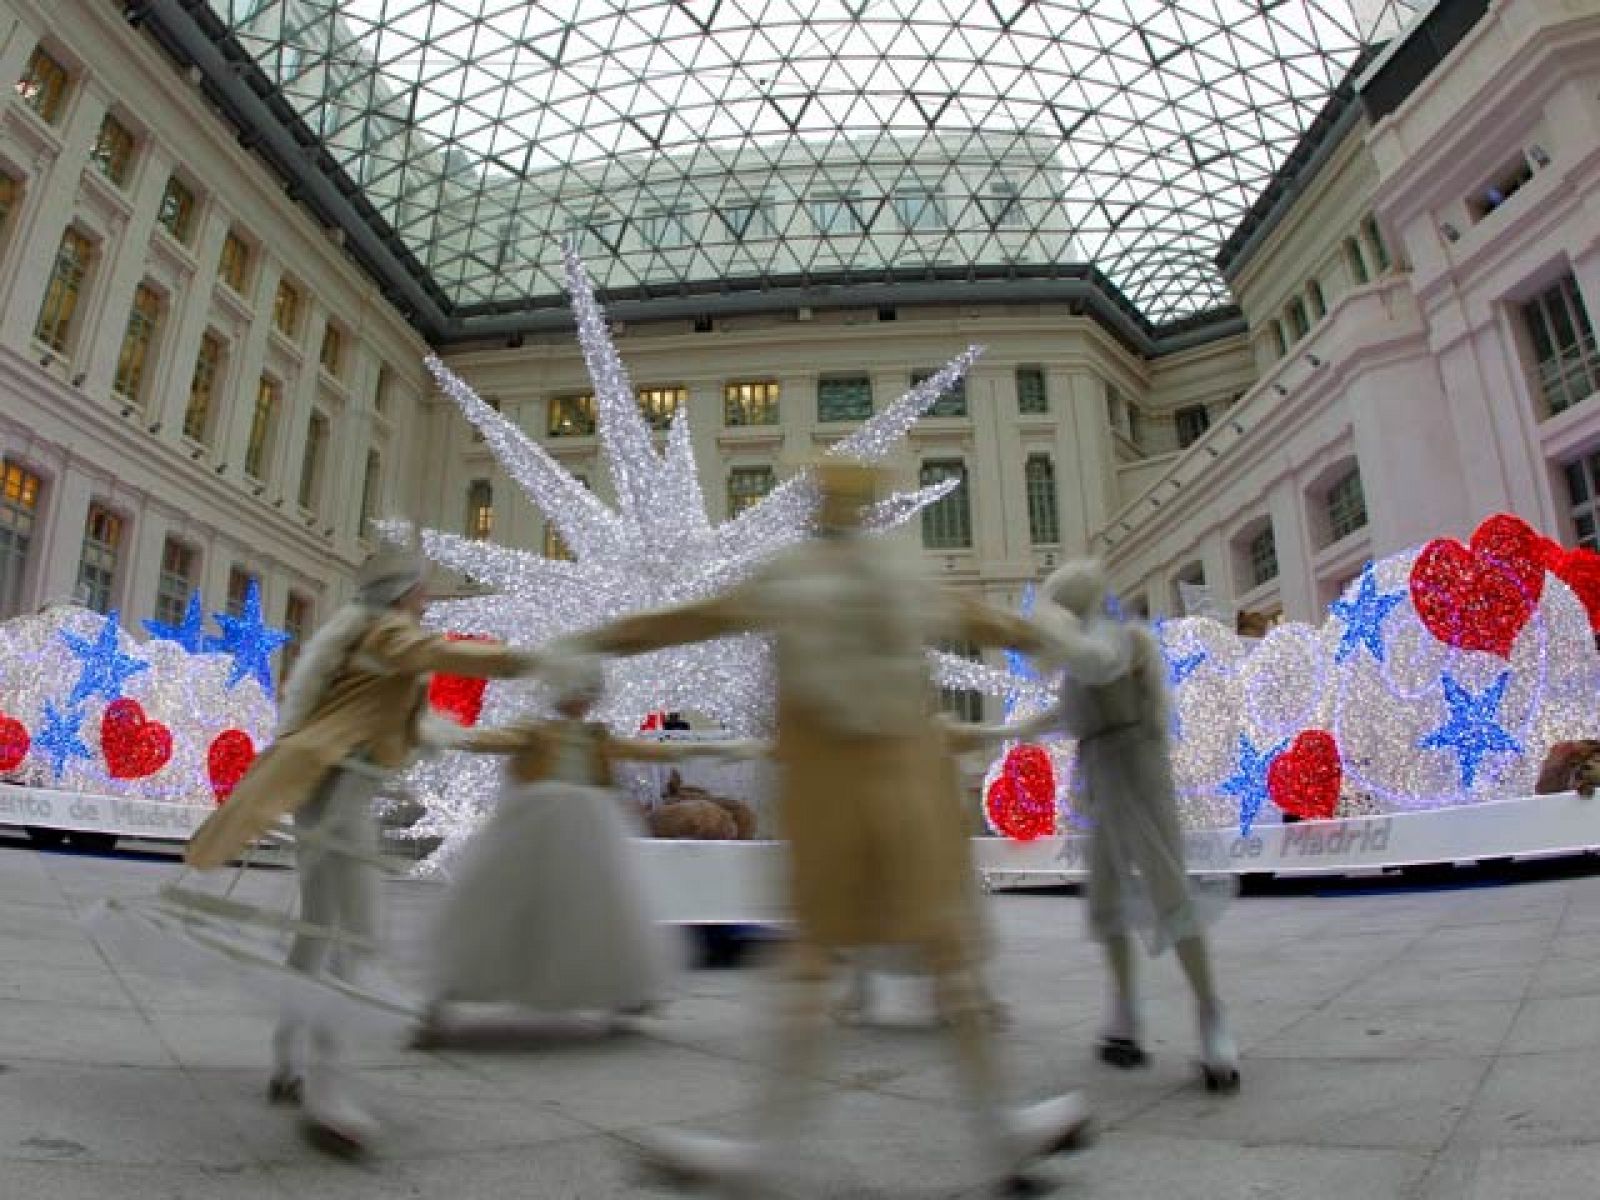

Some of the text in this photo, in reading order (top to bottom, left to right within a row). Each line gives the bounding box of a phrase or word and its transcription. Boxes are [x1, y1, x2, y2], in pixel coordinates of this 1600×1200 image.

[69, 797, 100, 821] de
[1229, 833, 1264, 858] de
[1279, 818, 1393, 857] Madrid
